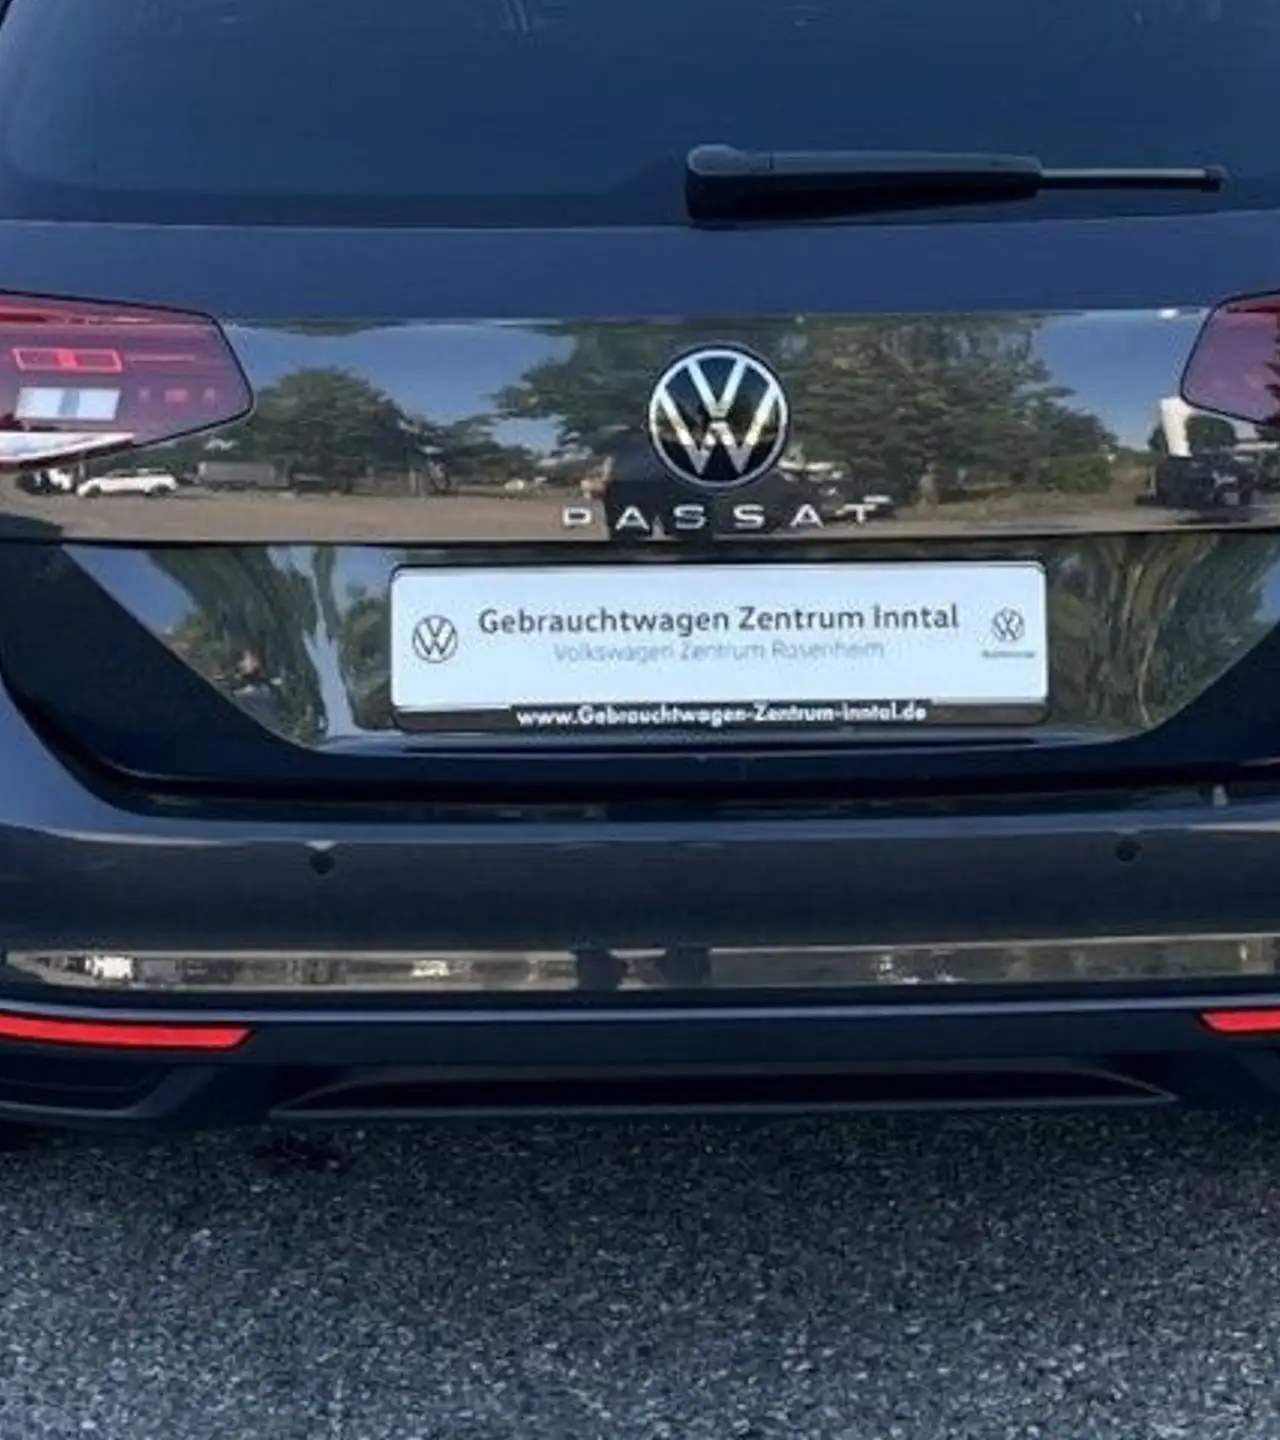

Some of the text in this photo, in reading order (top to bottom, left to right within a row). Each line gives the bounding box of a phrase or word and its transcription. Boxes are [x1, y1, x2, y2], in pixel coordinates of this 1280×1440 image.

[649, 345, 788, 488] VW
[562, 504, 878, 531] PASSAT
[479, 603, 959, 638] Gebrauchtwagen Zentrum Inntal
[412, 614, 459, 663] VW
[553, 638, 885, 664] Volkswagen Zentrum Rosenheim
